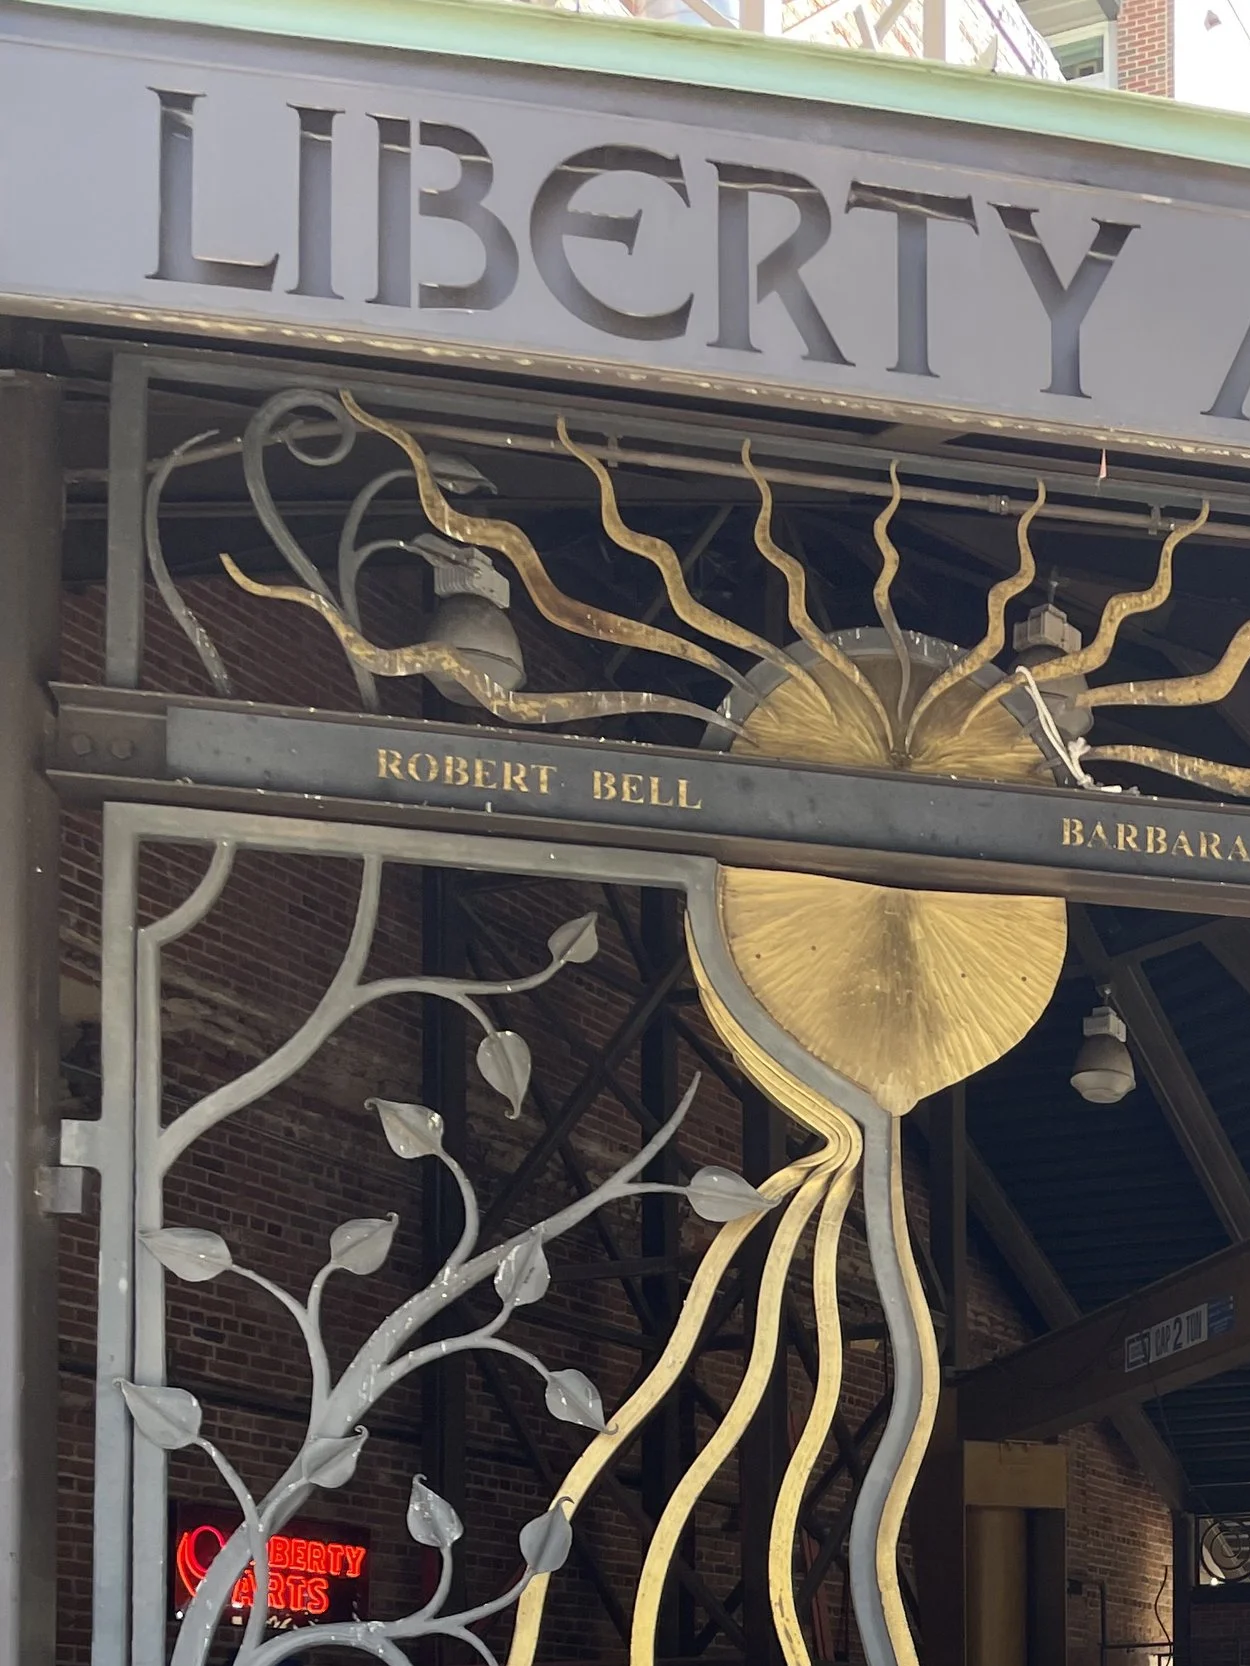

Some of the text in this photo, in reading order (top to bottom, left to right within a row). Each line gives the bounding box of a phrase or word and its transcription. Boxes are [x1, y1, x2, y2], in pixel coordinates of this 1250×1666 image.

[145, 86, 1141, 399] LIBERTY
[376, 748, 703, 810] ROBERT BELL
[1172, 1317, 1183, 1351] 2
[265, 1535, 366, 1578] BERTY
